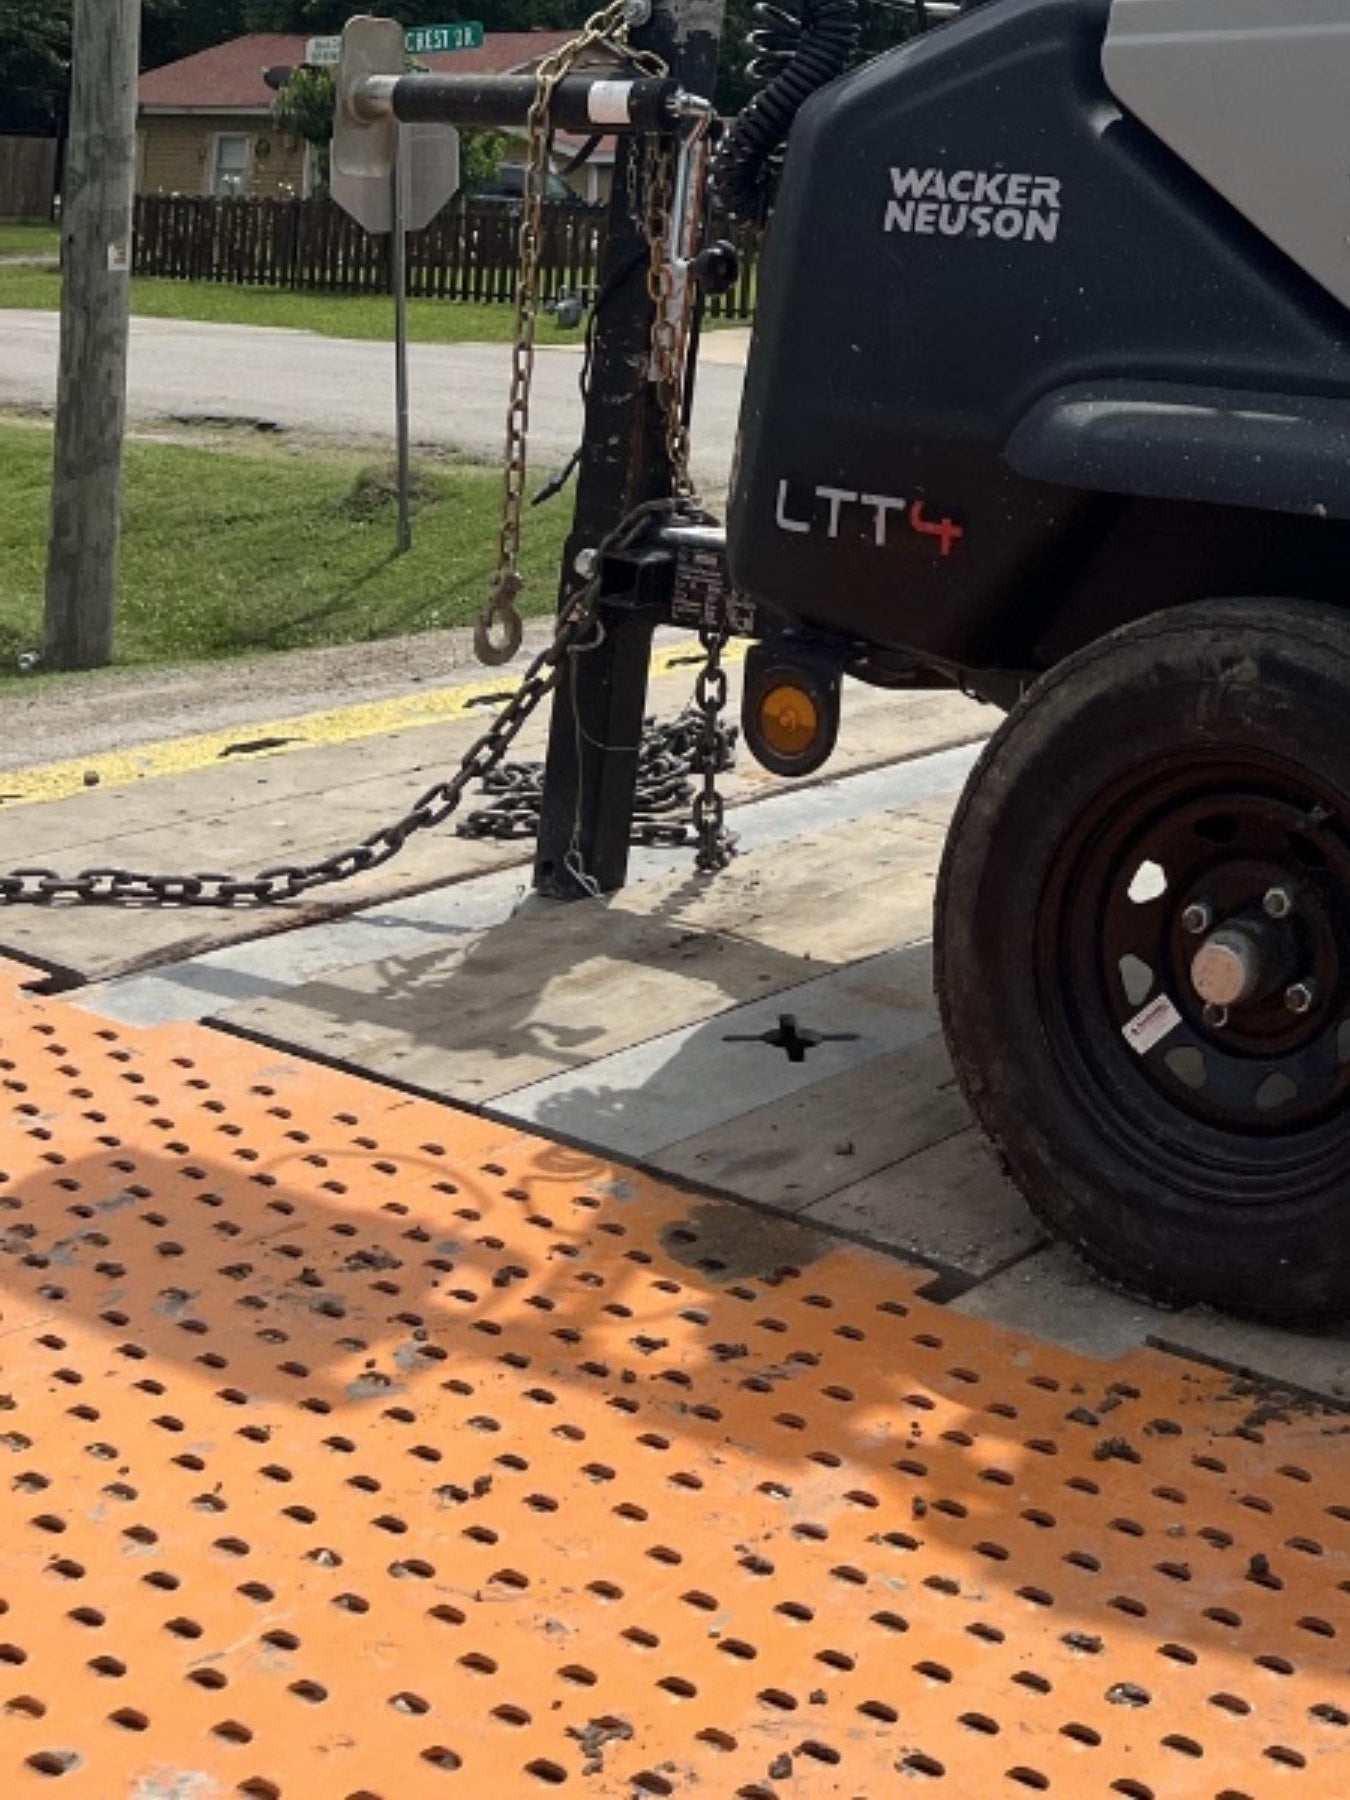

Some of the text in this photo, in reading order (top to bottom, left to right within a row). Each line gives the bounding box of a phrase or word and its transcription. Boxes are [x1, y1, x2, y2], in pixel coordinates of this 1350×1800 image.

[889, 166, 1062, 208] WACKER
[883, 201, 1060, 242] NEUSON
[775, 479, 963, 556] LTT4
